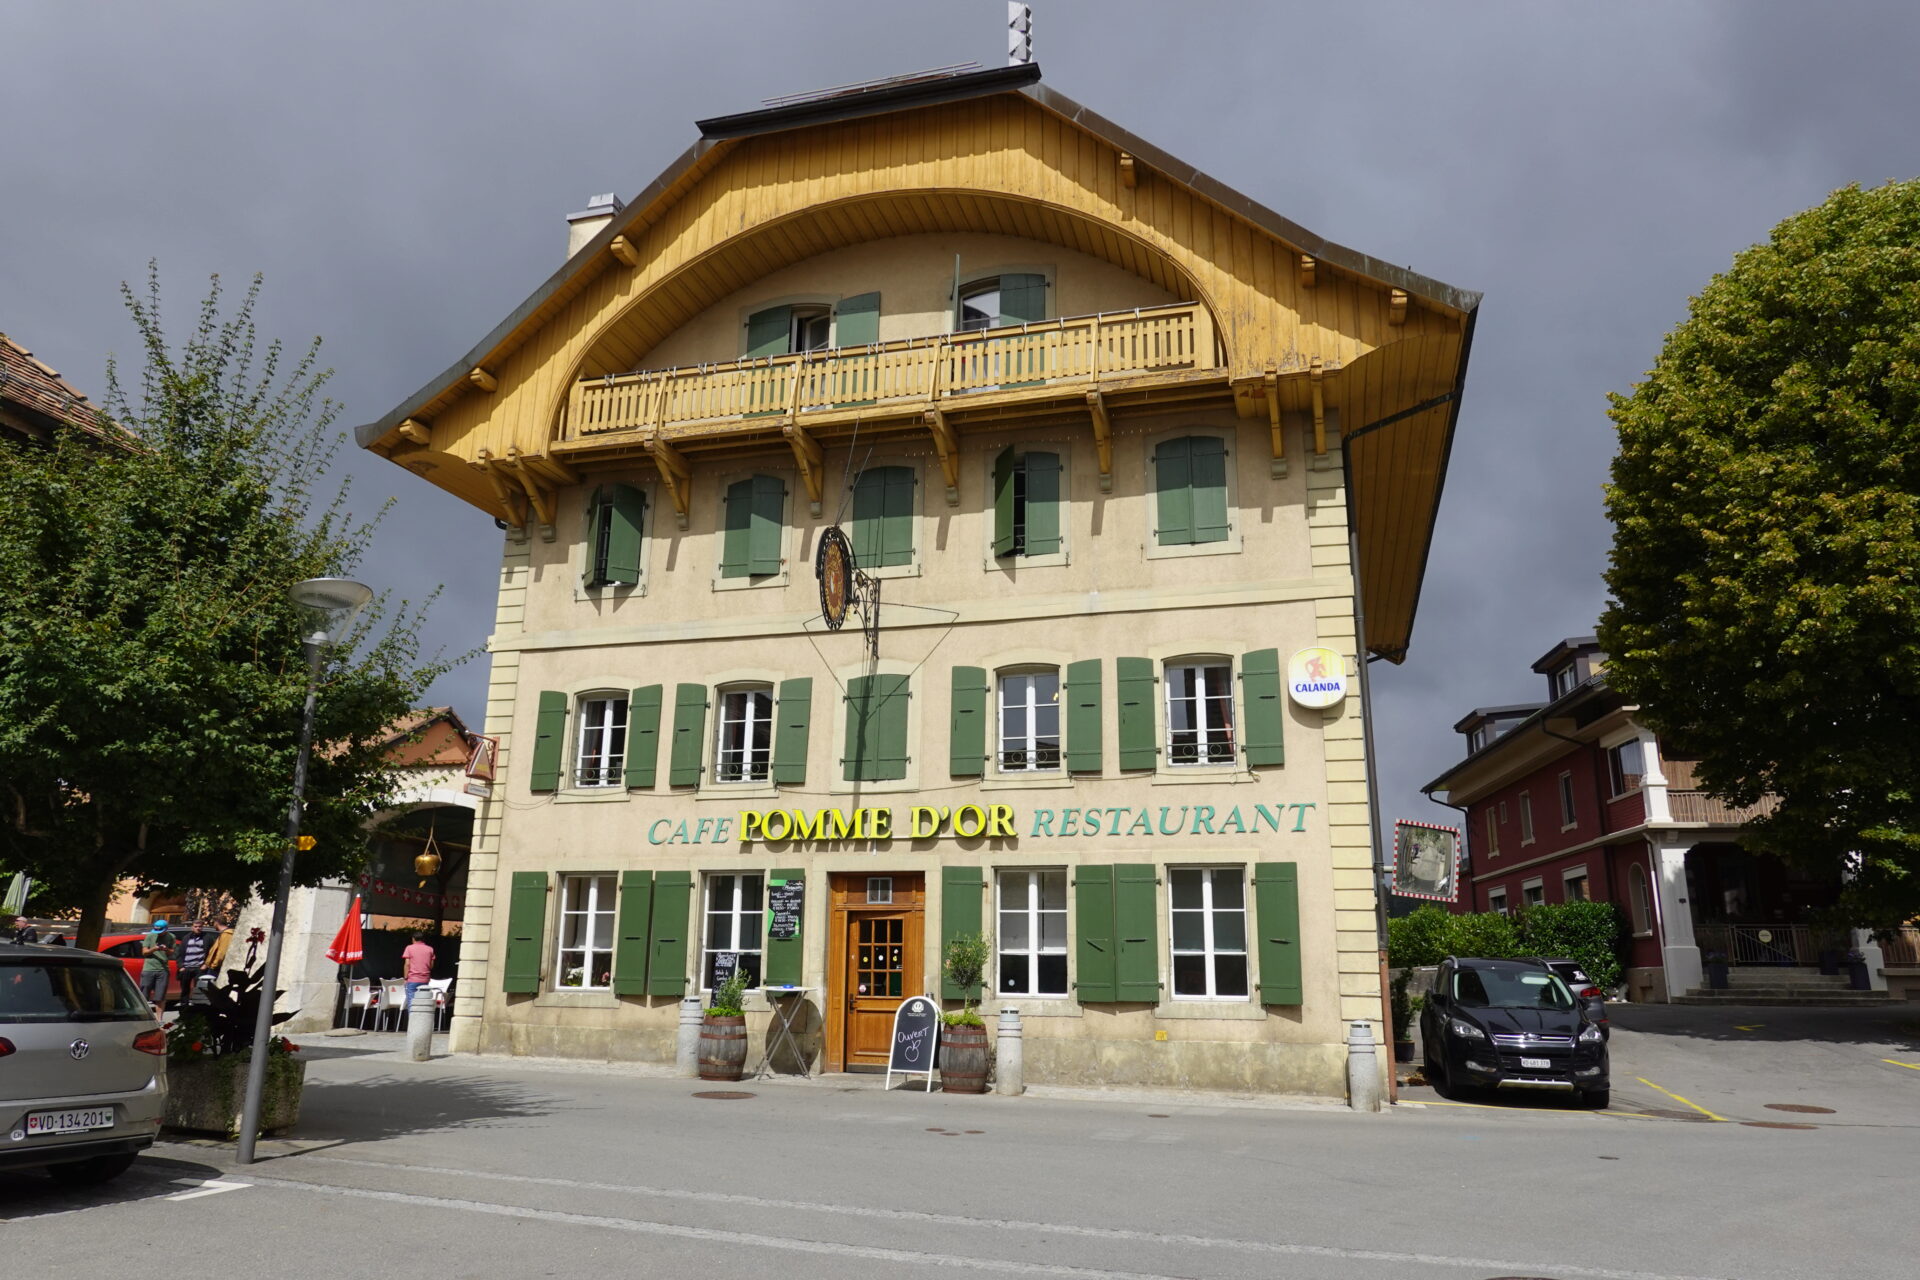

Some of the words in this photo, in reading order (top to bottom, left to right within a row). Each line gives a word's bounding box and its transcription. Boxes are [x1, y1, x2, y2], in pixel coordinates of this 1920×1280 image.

[1295, 682, 1340, 692] CALANDA
[647, 817, 733, 845] CAFE
[737, 807, 893, 842] POMME
[909, 803, 1019, 839] D'OR
[1030, 802, 1317, 838] RESTAURANT
